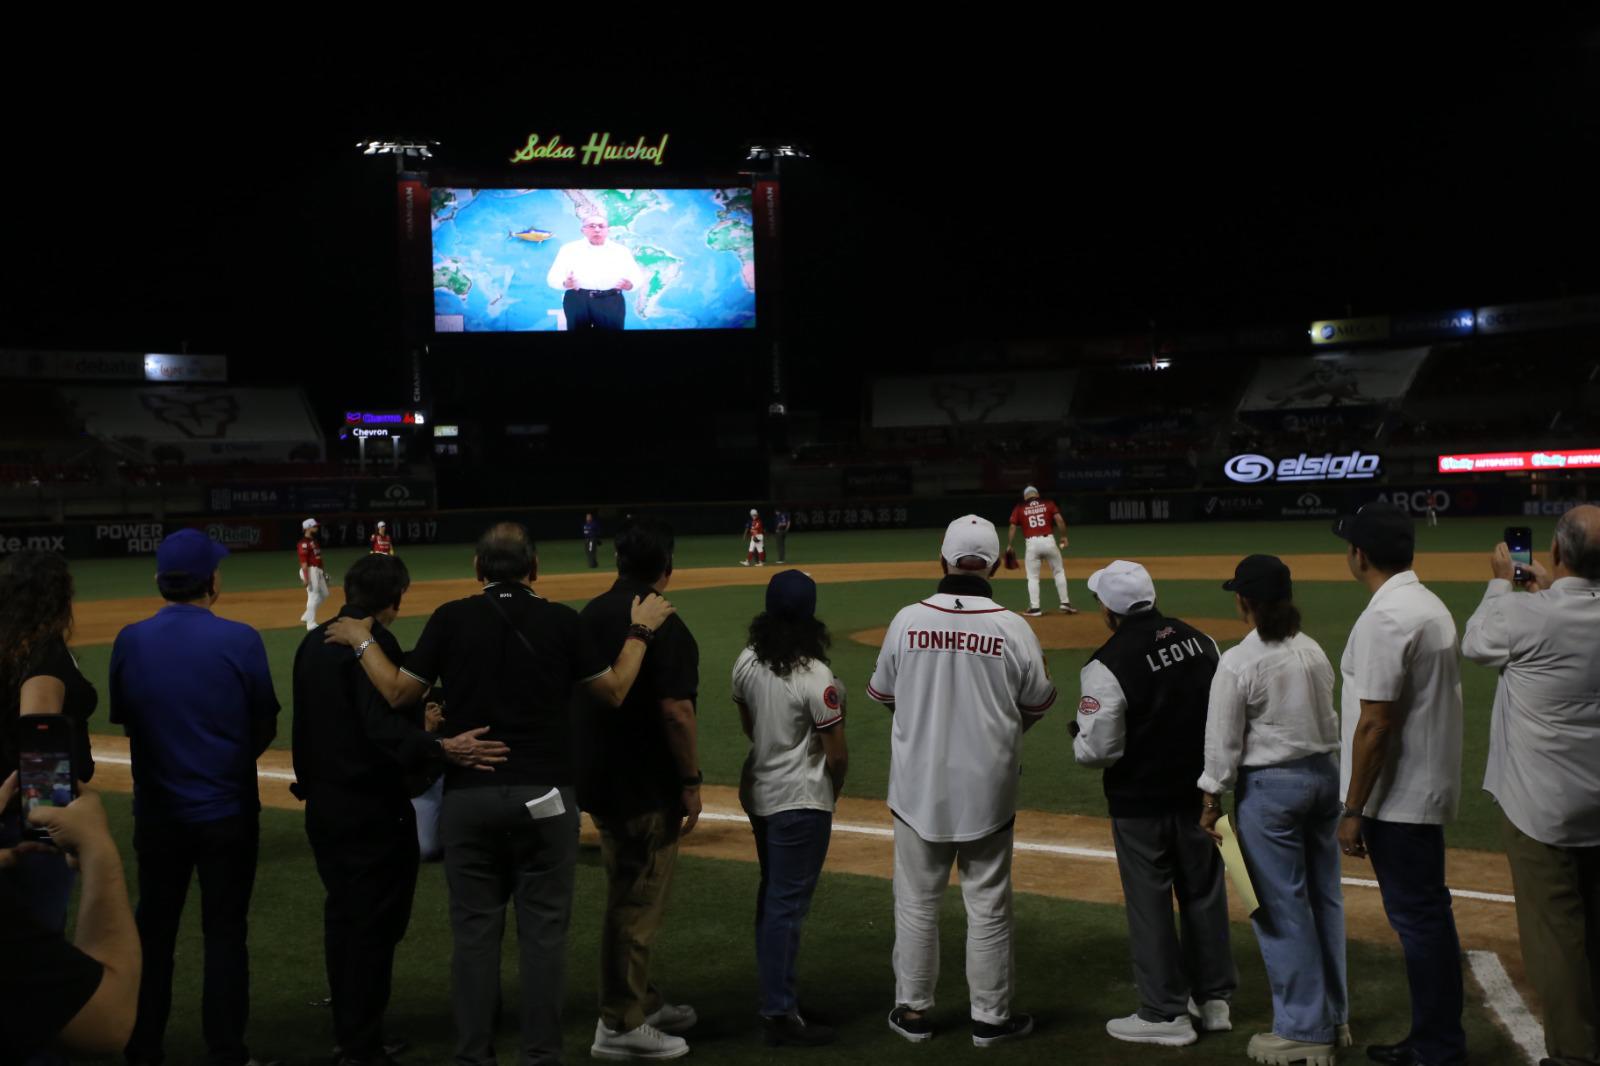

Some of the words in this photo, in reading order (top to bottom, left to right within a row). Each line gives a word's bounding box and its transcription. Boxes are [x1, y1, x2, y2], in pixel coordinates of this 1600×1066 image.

[510, 133, 576, 163] Salsa
[580, 132, 669, 165] Huichol
[353, 427, 388, 437] Chevron
[1276, 450, 1380, 479] elsiglo
[233, 489, 278, 501] HERSA
[407, 522, 421, 538] 13
[424, 521, 438, 538] 17
[1028, 514, 1046, 528] 65
[96, 523, 163, 540] POWER
[907, 630, 1004, 656] TONHEQUE
[1146, 637, 1204, 672] LEOVI
